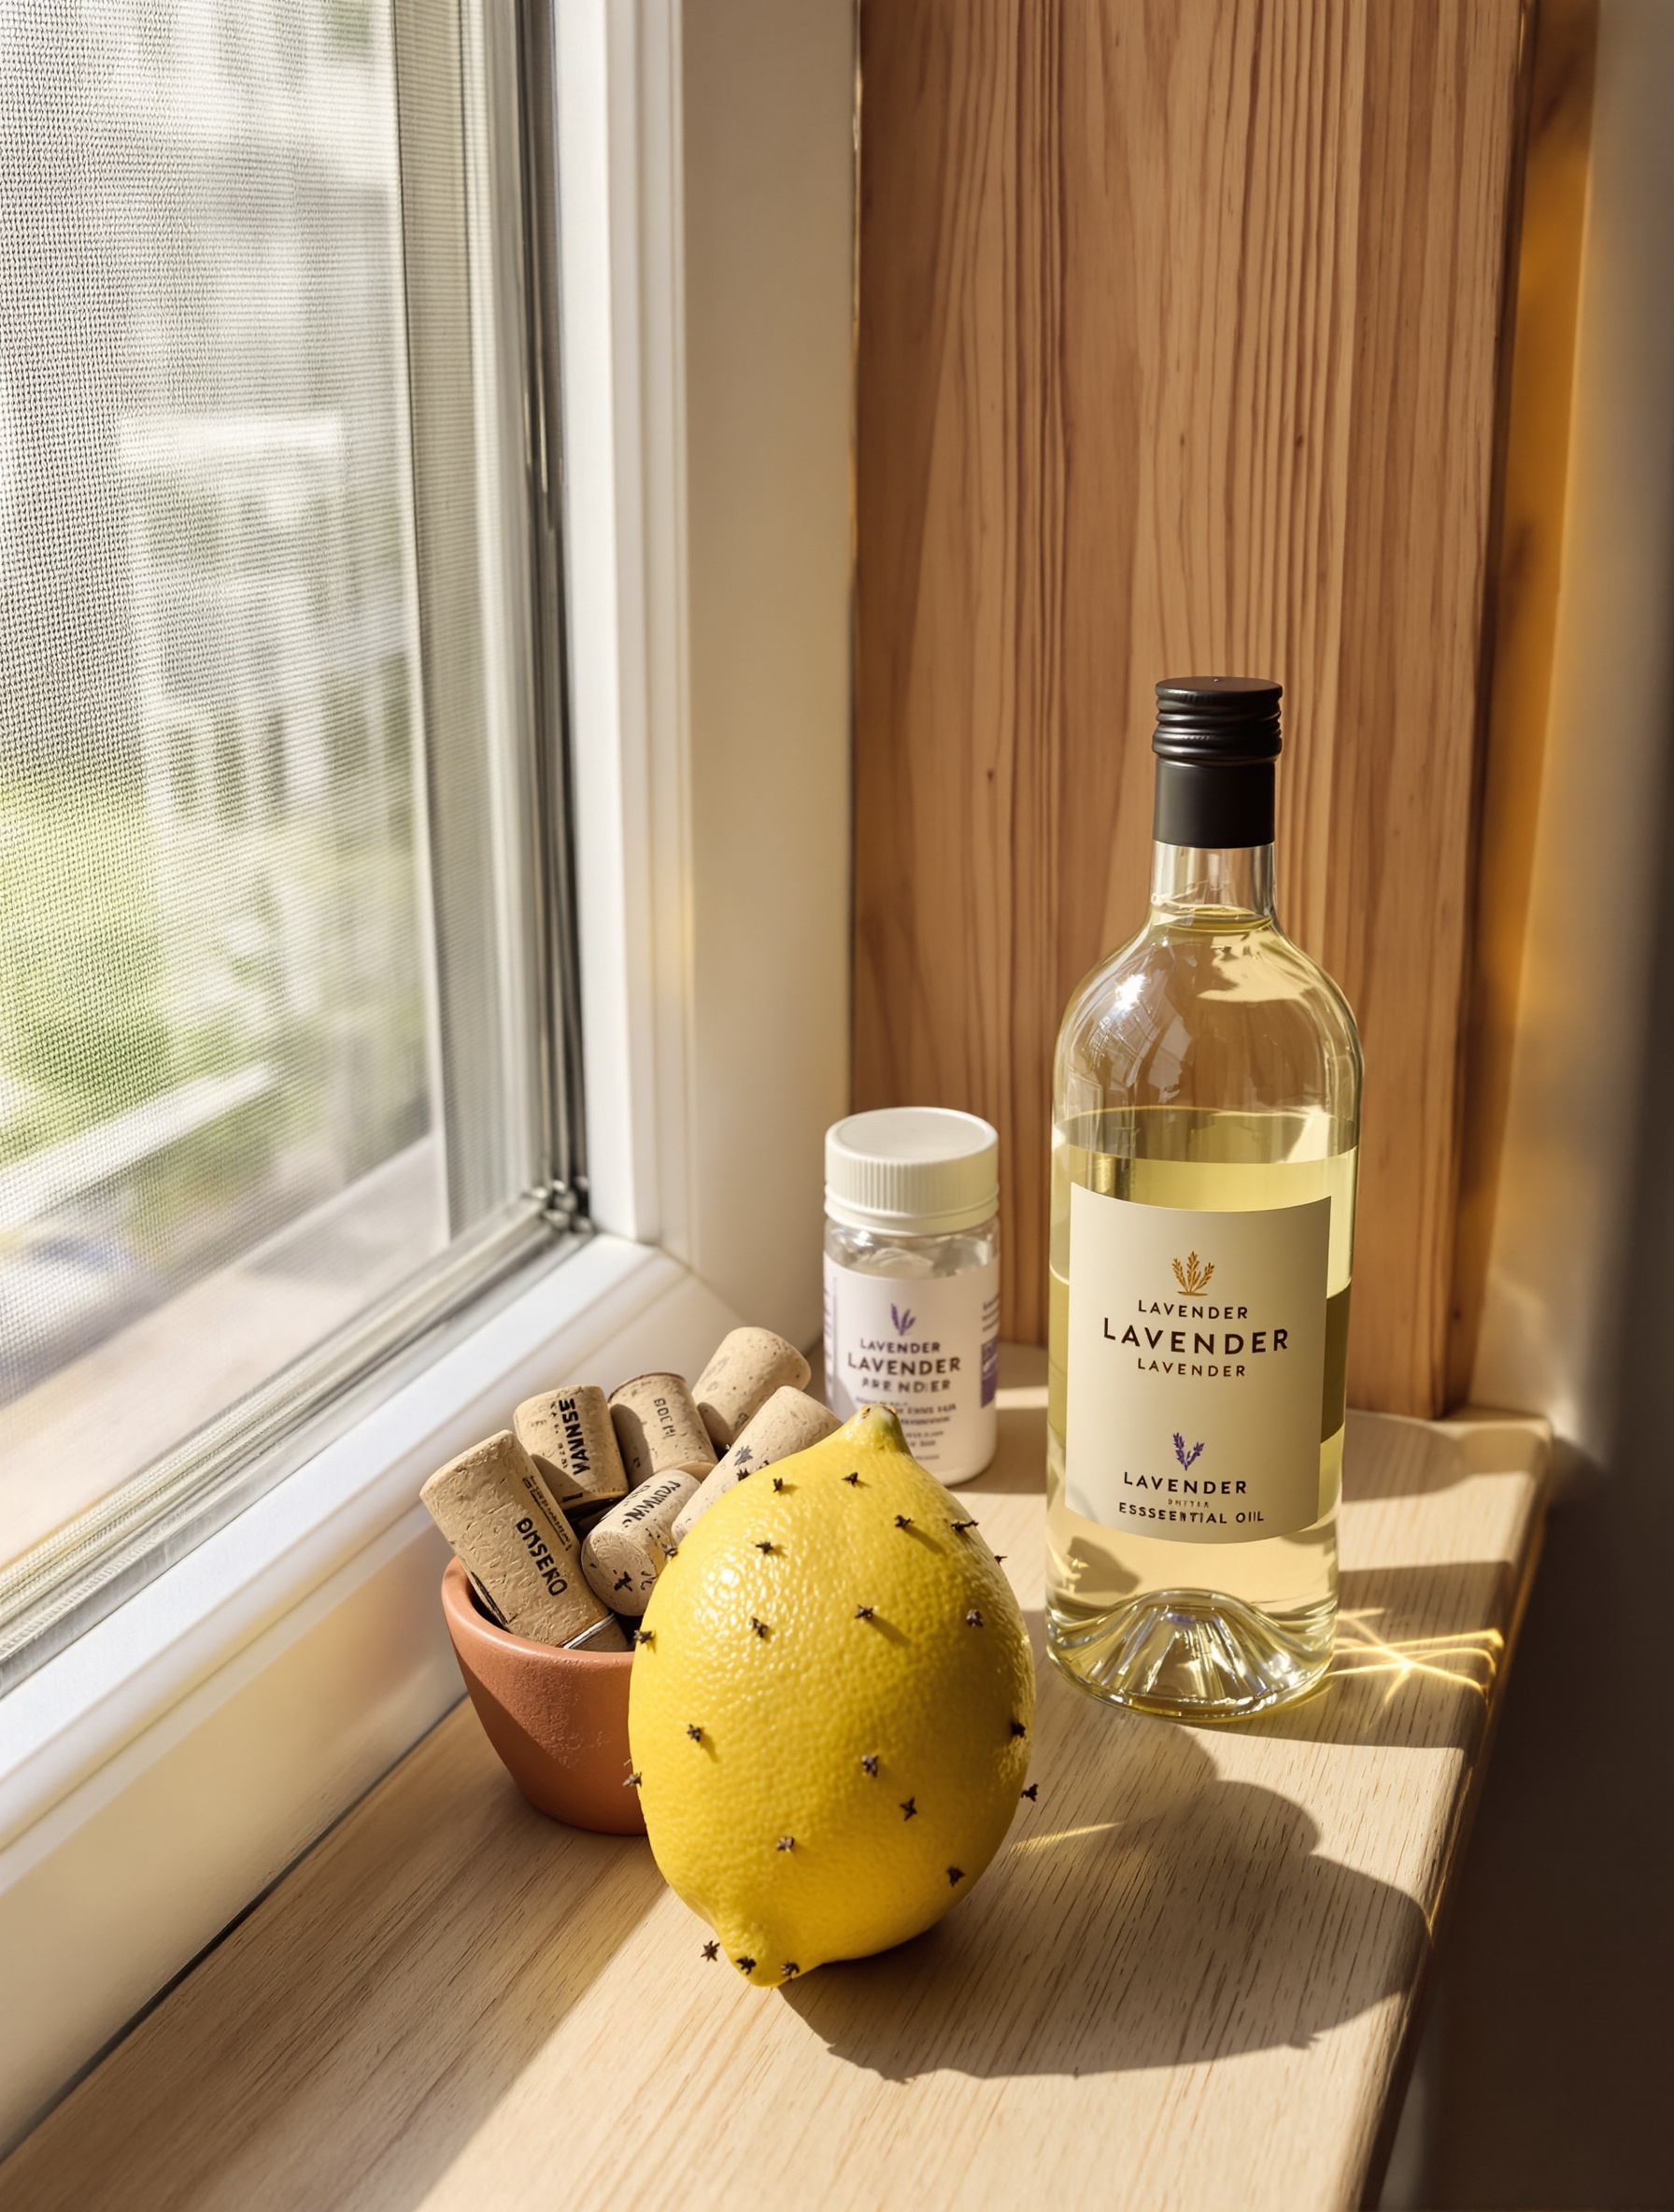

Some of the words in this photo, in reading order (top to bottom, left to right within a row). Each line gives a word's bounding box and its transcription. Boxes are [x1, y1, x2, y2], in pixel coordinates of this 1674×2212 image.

[1138, 1299, 1249, 1320] LAVENDER
[860, 1338, 941, 1354] LAVENDER
[1103, 1317, 1289, 1355] LAVENDER
[847, 1352, 961, 1376] LAVENDER
[1137, 1357, 1246, 1377] LAVENDER
[1123, 1471, 1248, 1495] LAVENDER
